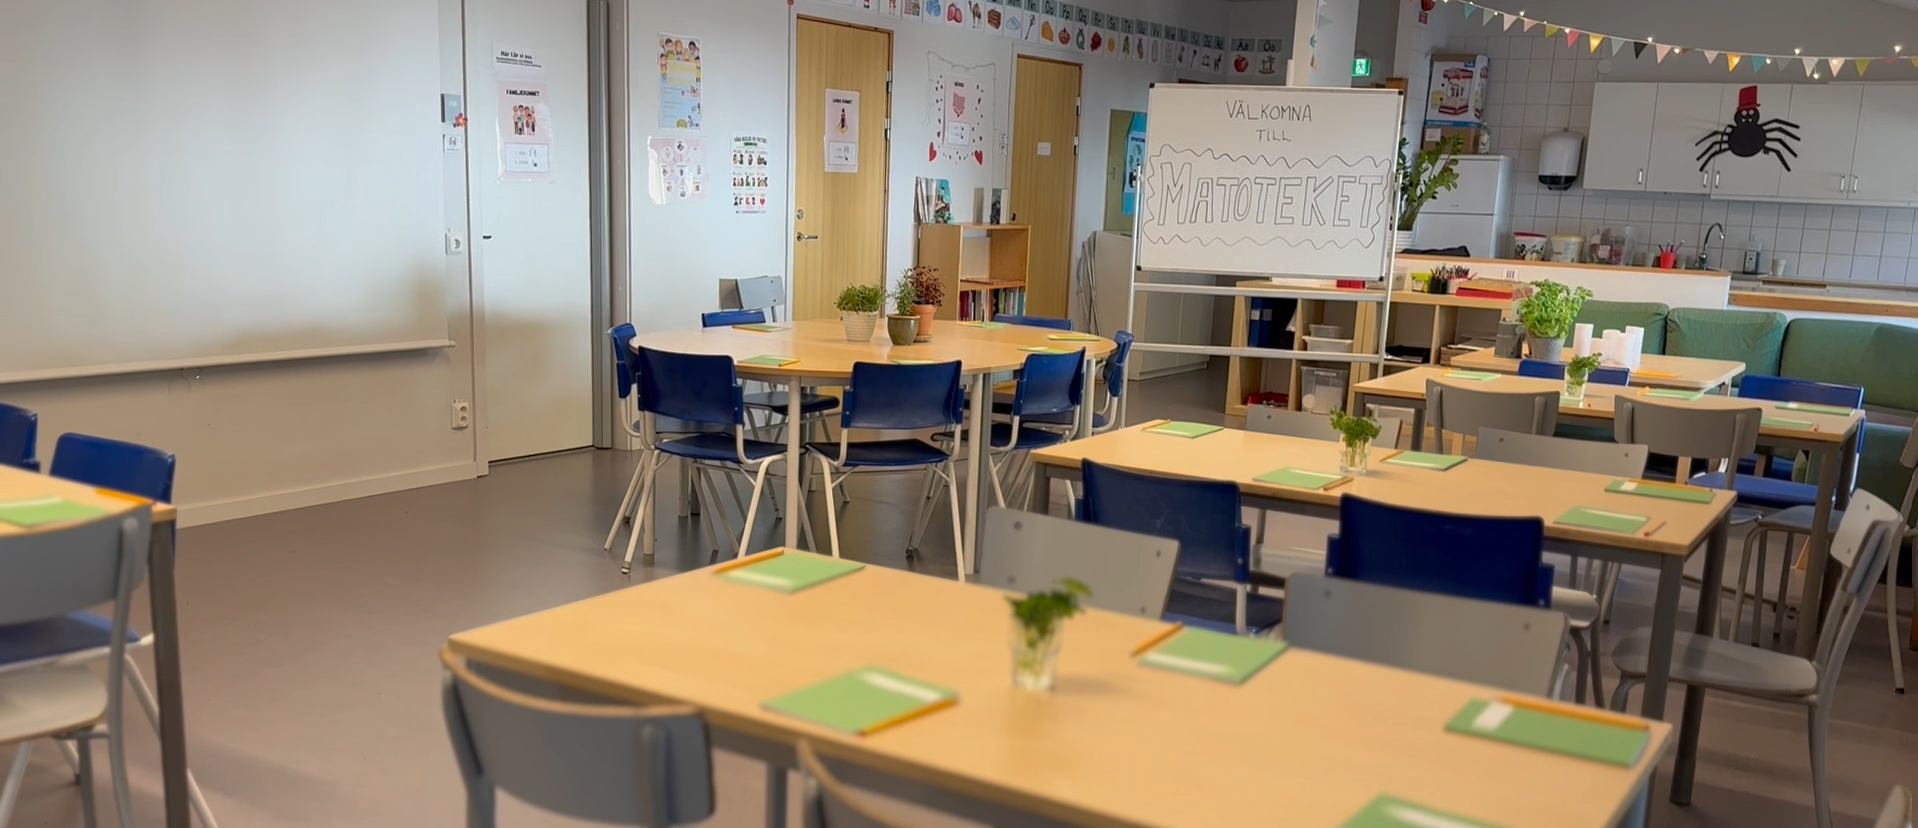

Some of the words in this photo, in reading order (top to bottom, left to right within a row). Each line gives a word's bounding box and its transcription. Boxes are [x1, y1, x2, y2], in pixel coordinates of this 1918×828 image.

[1045, 1, 1054, 15] Oo
[1063, 5, 1070, 20] Pp
[1226, 99, 1312, 122] VÄLKOMNA
[1256, 128, 1291, 142] TILL
[1157, 162, 1384, 228] MATOTEKET
